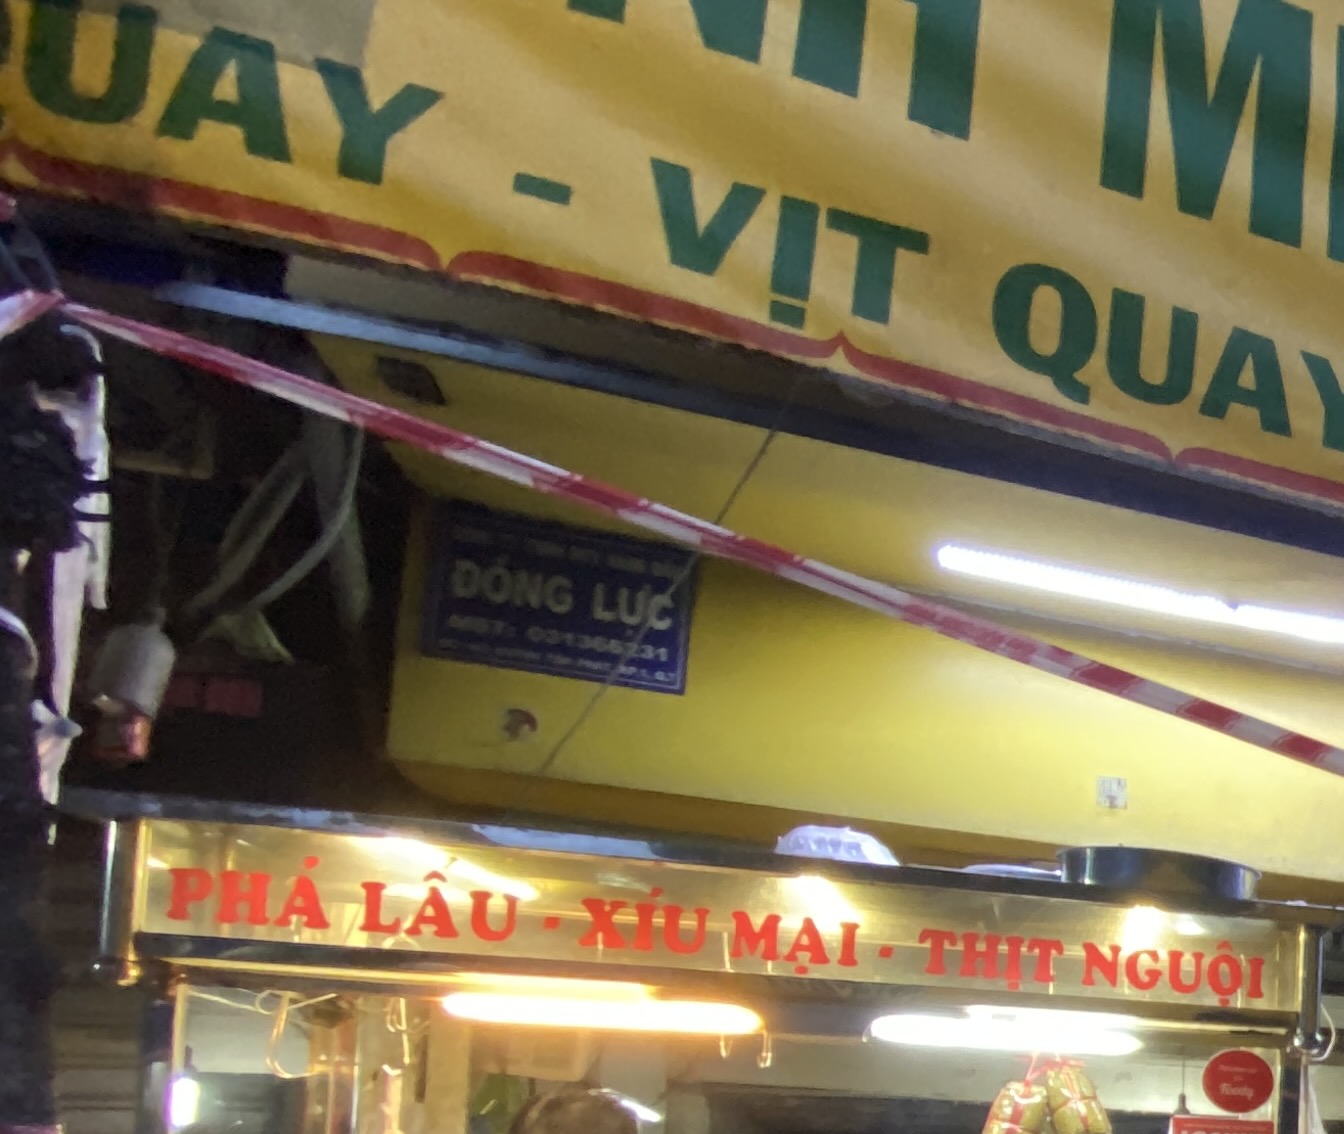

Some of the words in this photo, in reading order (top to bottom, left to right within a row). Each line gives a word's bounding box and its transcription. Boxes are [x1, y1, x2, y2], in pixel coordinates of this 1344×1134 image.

[0, 0, 445, 186] UAY
[650, 157, 930, 329] VỊT
[578, 887, 710, 955] XÍU
[731, 911, 861, 975] MẠI
[918, 928, 1064, 990] THỊT
[1081, 939, 1266, 1007] NGUỘI
